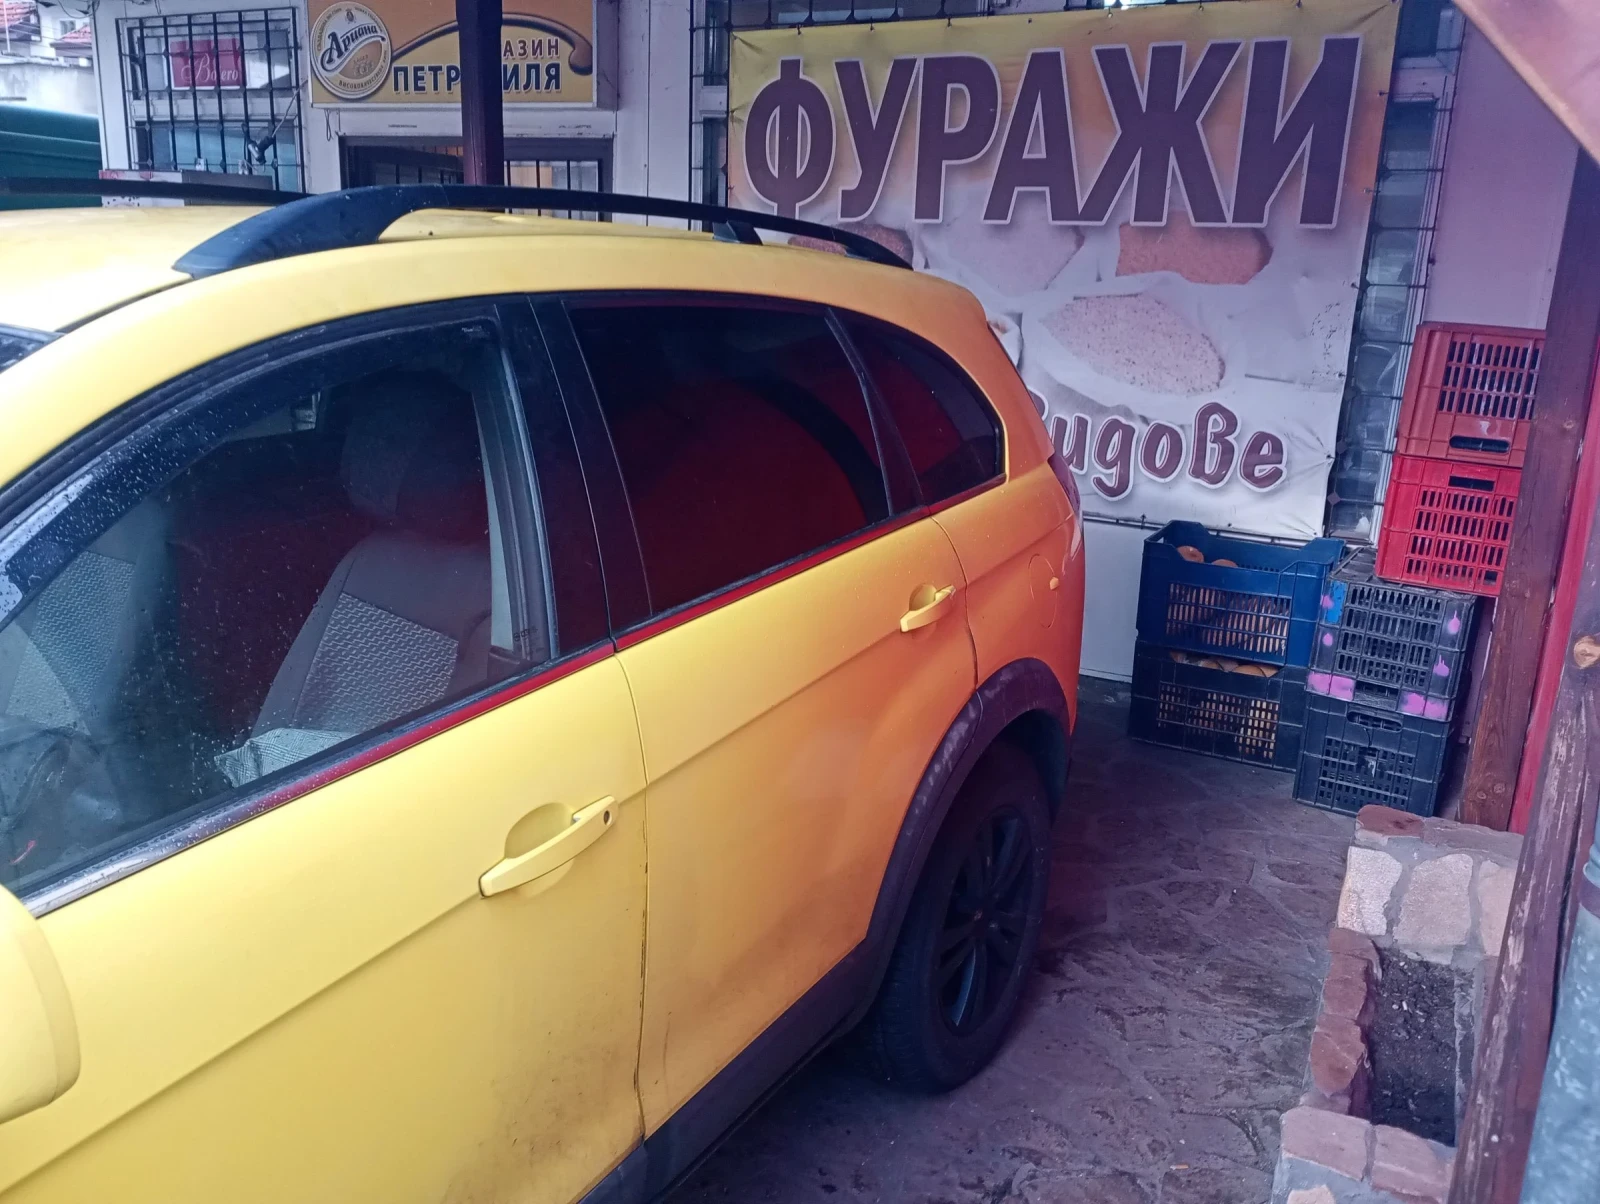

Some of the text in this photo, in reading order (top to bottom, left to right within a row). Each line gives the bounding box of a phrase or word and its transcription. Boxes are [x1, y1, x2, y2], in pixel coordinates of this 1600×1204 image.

[181, 53, 239, 82] Boero
[321, 25, 381, 71] Ариана
[503, 38, 559, 58] АЗИН
[743, 35, 1361, 227] ФУРАЖИ
[1028, 388, 1287, 500] идове
